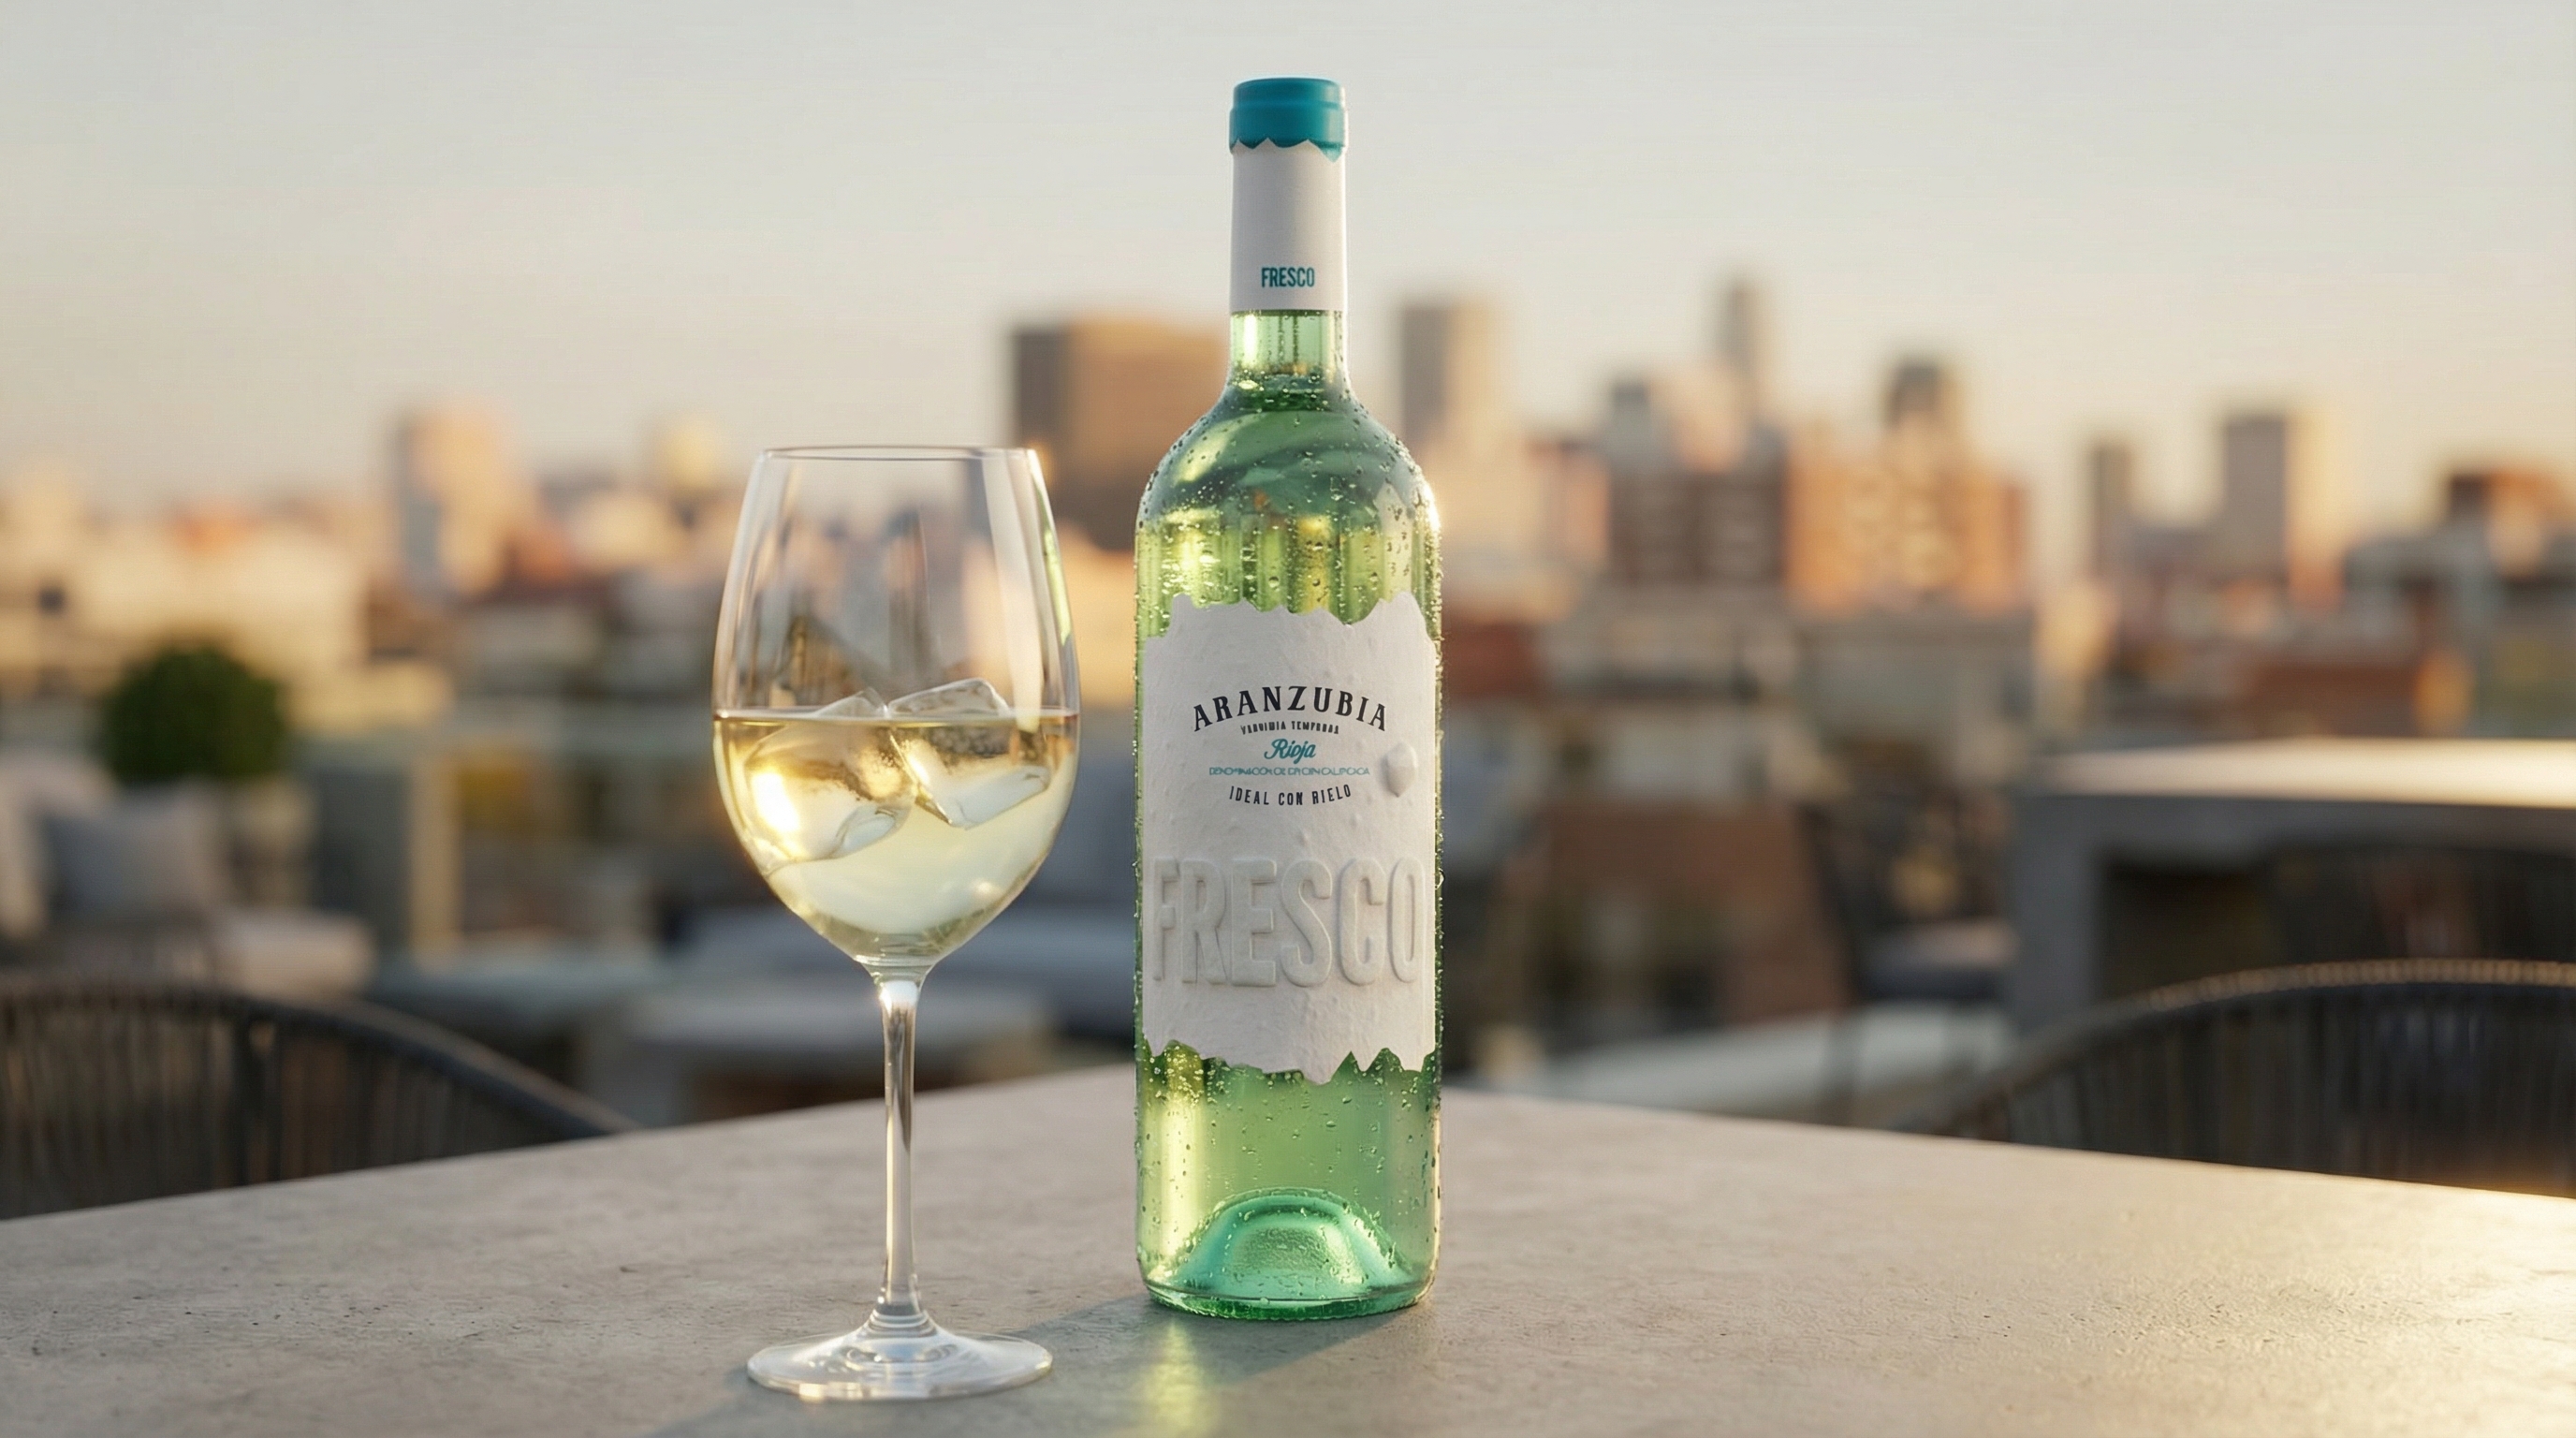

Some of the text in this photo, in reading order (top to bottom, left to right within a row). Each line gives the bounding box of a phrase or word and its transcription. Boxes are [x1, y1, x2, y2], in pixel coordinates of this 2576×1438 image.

[1261, 267, 1315, 288] FRESCO
[1193, 685, 1385, 732] ARANZUBIA
[1264, 738, 1317, 765] Rioja
[1229, 785, 1270, 805] IDEAL
[1278, 792, 1303, 806] CON
[1153, 857, 1427, 988] FRESCO
